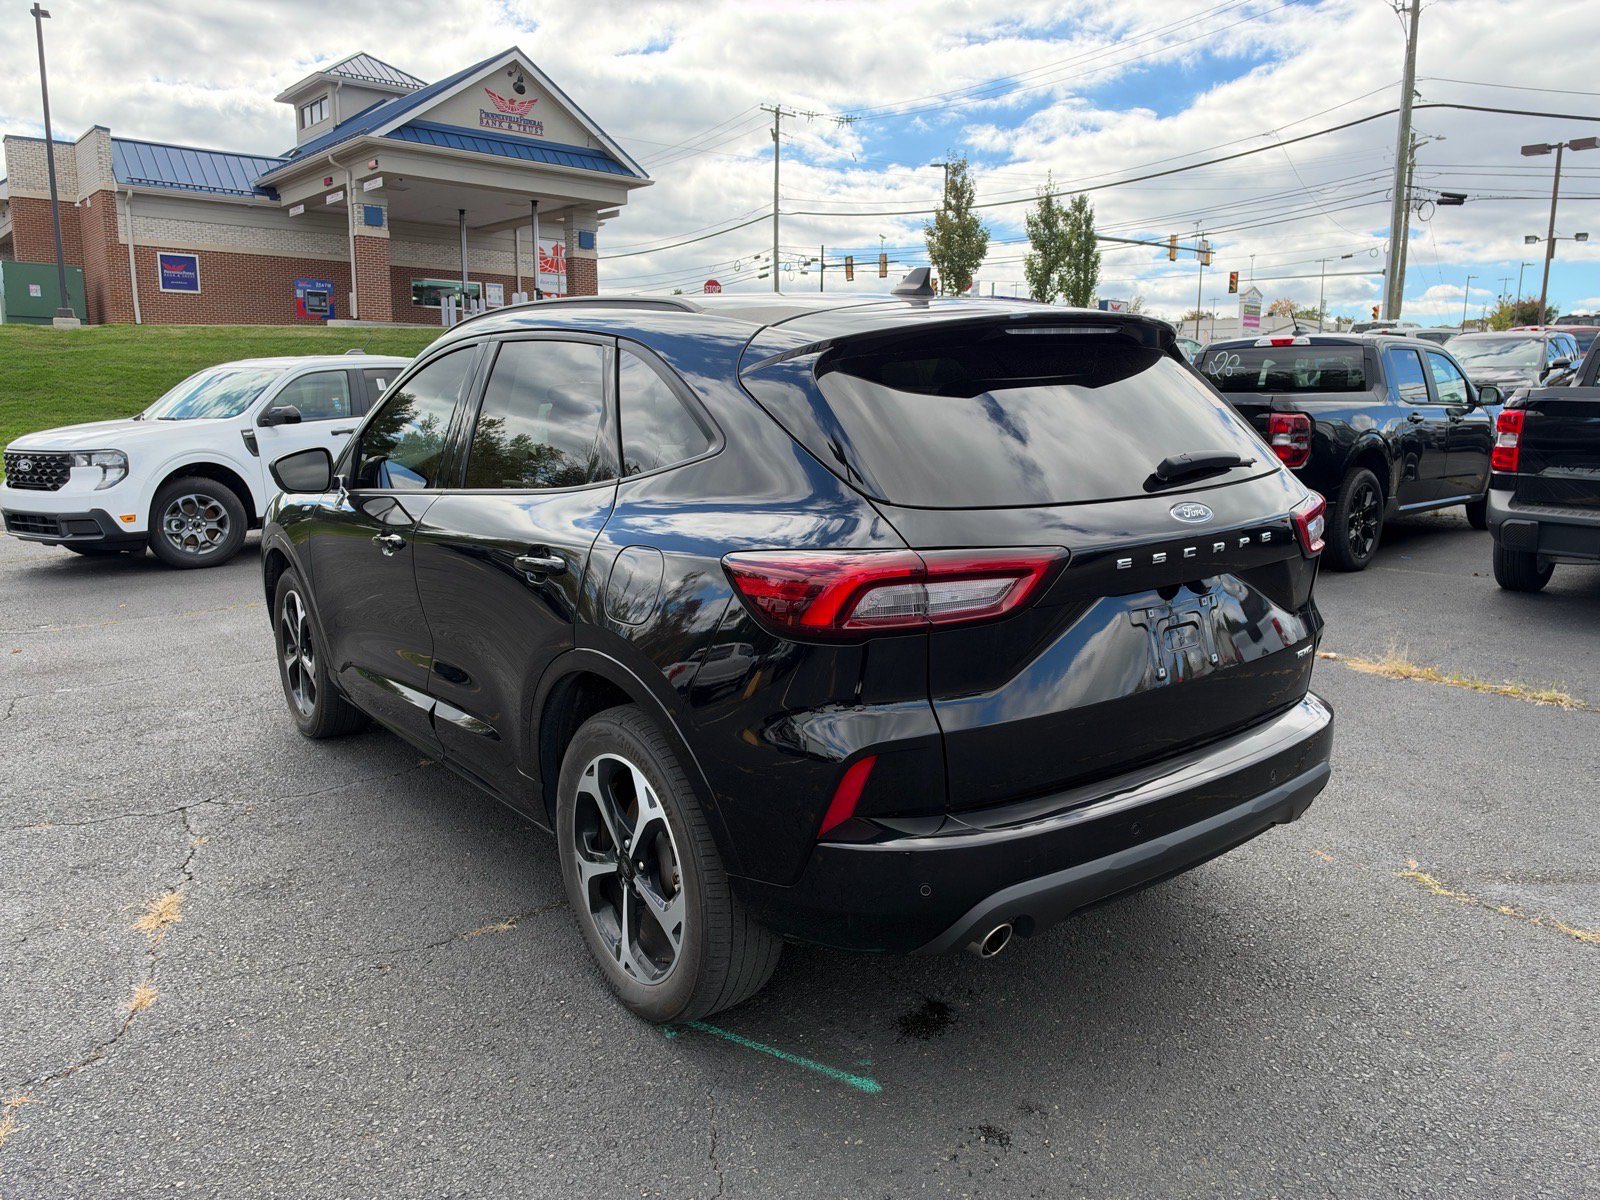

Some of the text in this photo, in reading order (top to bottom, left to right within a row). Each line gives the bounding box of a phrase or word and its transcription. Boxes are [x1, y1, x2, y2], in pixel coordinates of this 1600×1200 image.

[480, 118, 503, 128] BANK
[517, 124, 543, 135] TRUST
[705, 285, 720, 294] STOP
[1116, 531, 1272, 570] ESCAPE
